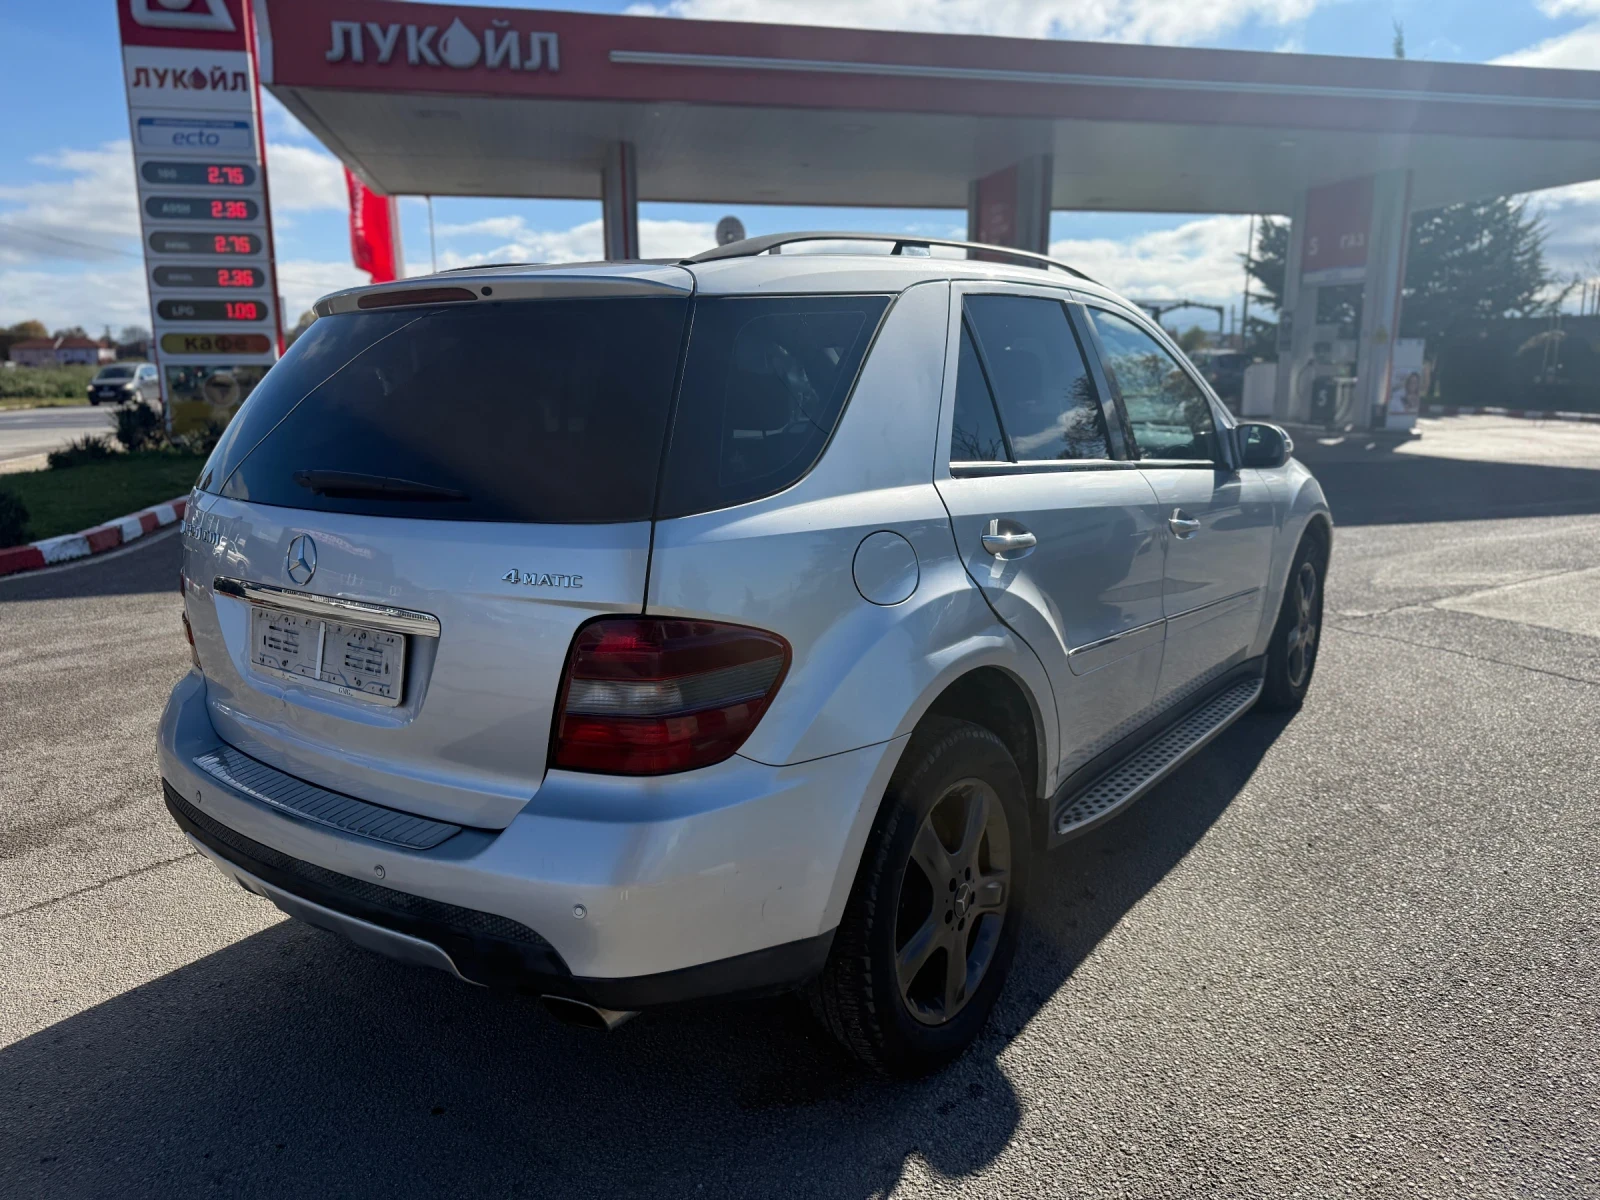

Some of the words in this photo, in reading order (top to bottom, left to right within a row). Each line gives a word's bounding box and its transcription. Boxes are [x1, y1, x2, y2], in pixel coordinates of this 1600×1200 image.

[325, 16, 560, 71] ЛУКОЙЛ
[132, 66, 248, 92] ЛУКОЙЛ
[172, 130, 220, 146] ecto
[225, 302, 257, 320] 1.09
[501, 568, 583, 588] 4MATIC
